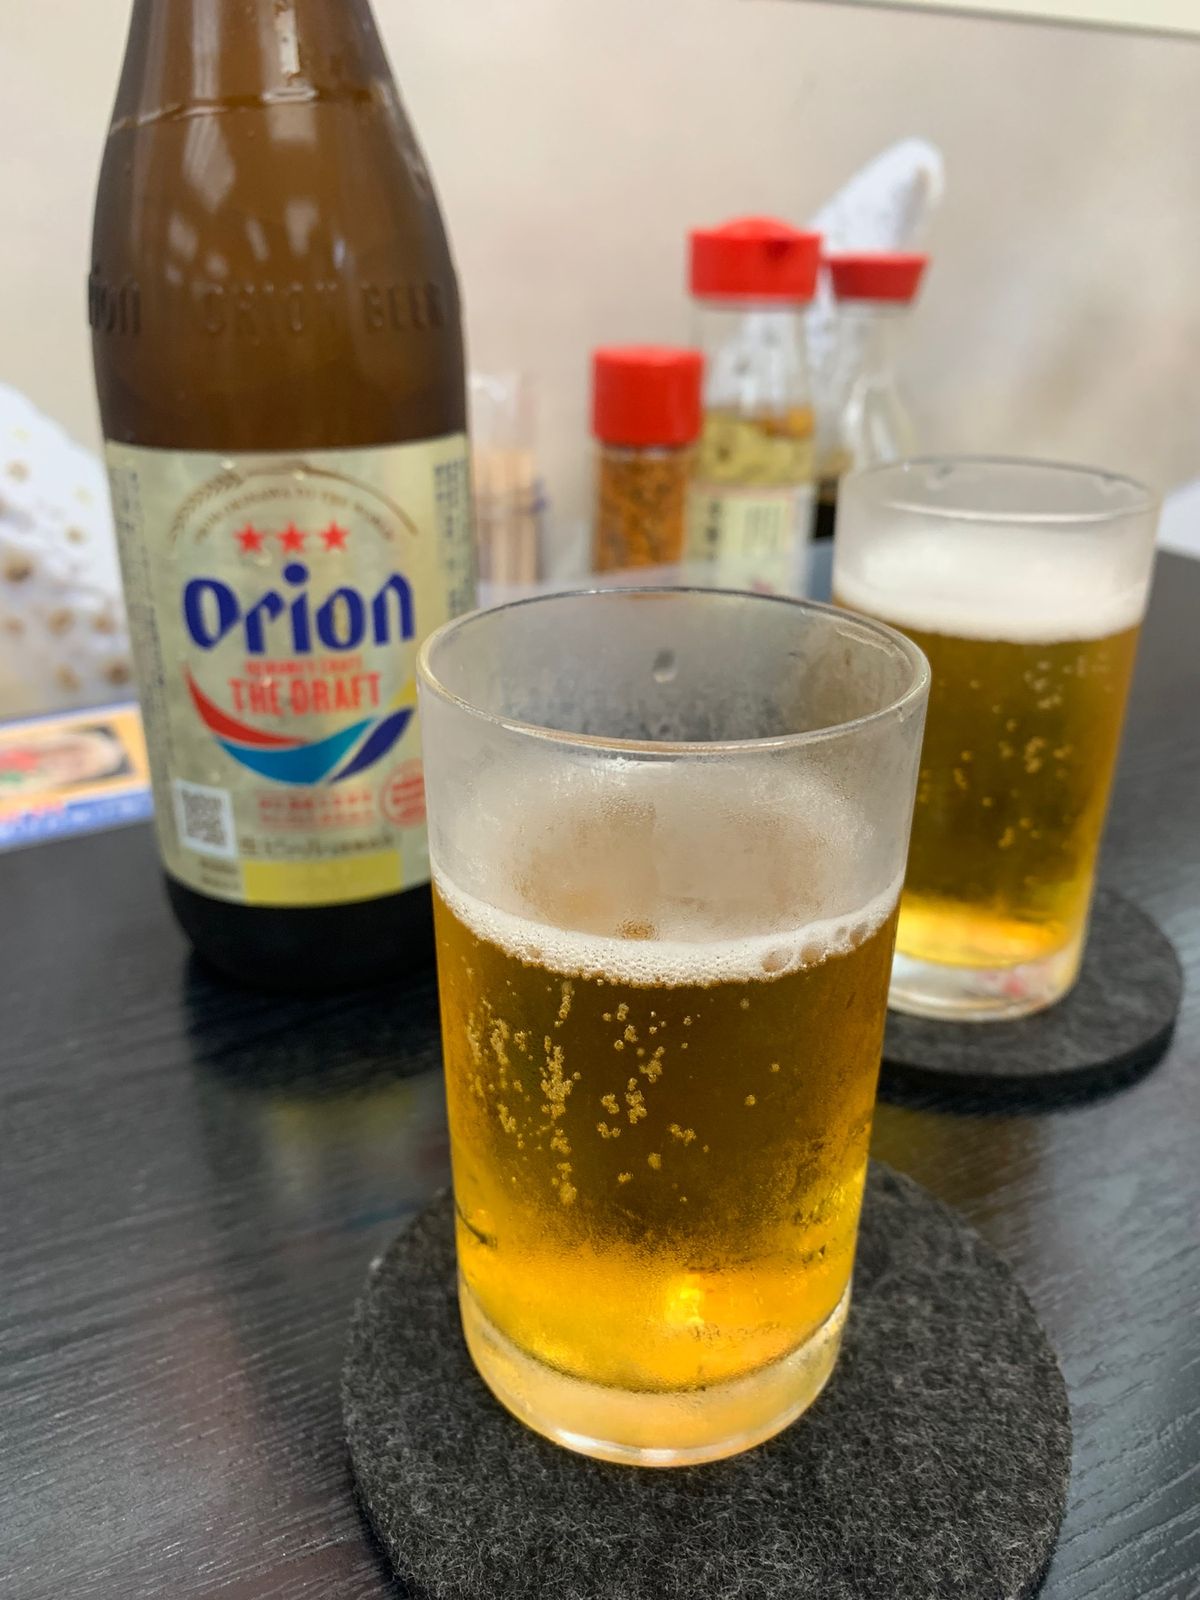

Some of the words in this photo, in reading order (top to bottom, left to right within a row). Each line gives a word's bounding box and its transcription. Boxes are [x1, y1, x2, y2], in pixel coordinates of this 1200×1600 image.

[182, 562, 416, 655] Orion
[229, 677, 284, 717] THE
[290, 671, 381, 716] DRAFT
